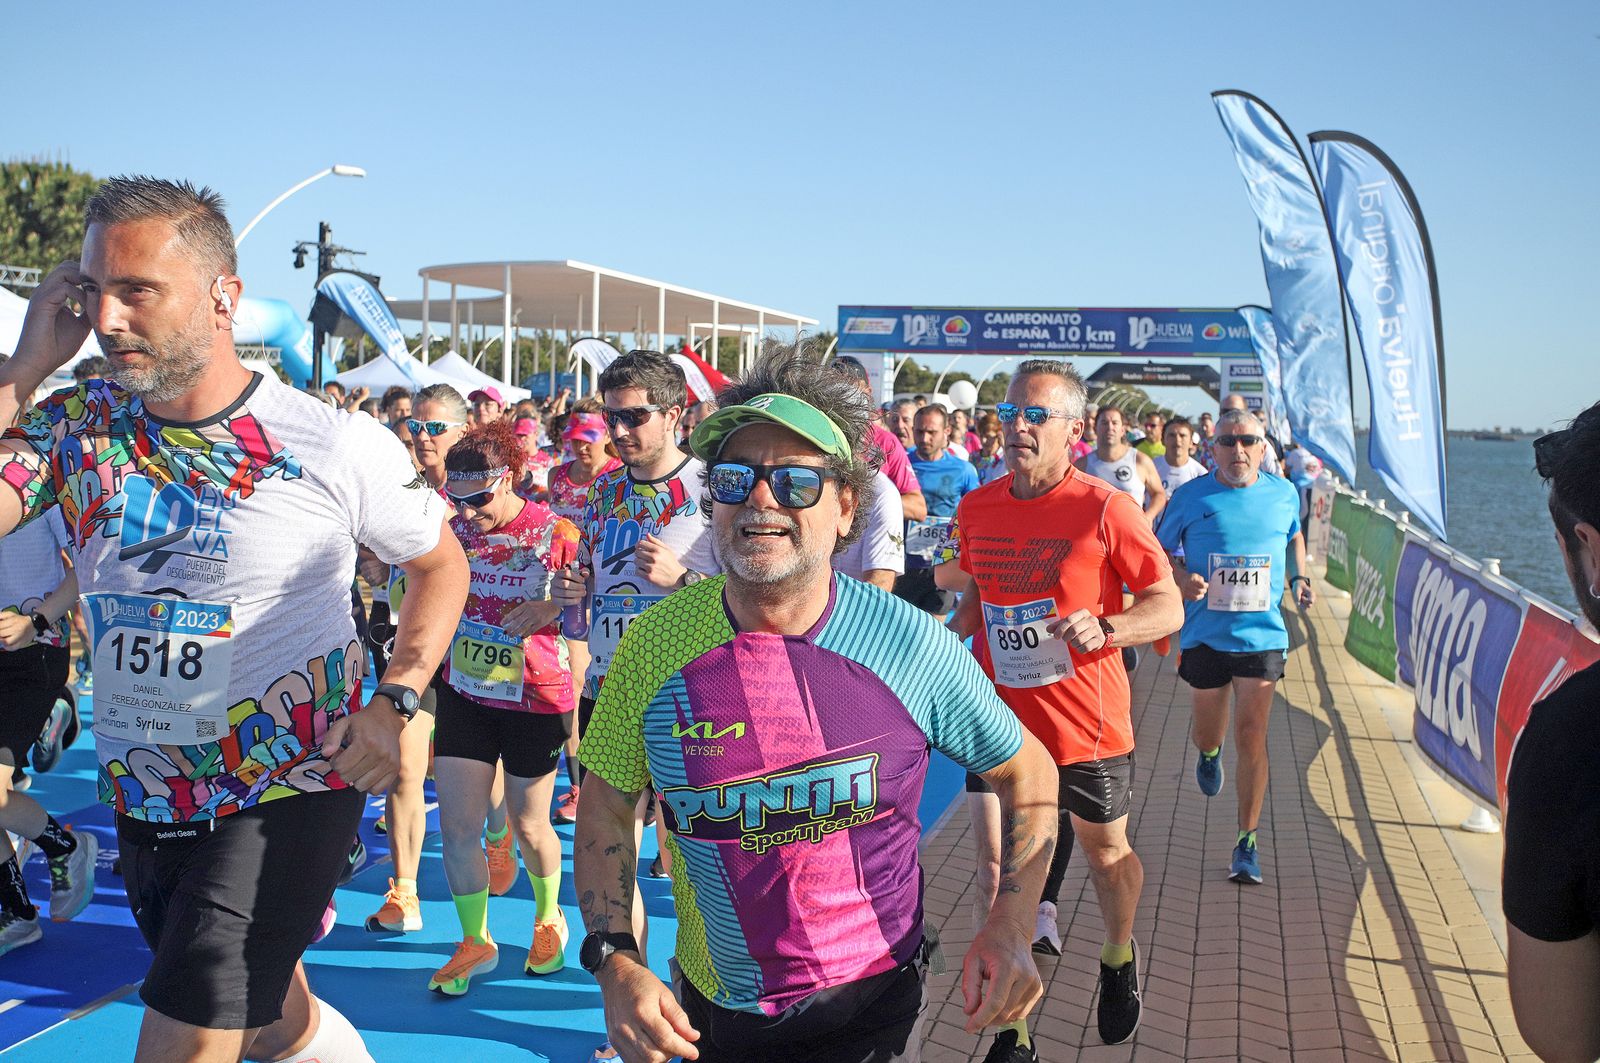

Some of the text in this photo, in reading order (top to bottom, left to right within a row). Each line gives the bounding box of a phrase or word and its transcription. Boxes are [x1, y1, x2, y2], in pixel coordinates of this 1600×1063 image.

[984, 312, 1081, 325] CAMPEONATO
[983, 325, 1115, 342] de ESPAÑA 10 km
[1154, 323, 1194, 337] HUELVA
[1047, 341, 1080, 350] Absoluto
[1088, 341, 1115, 350] Master
[195, 508, 232, 534] EL
[193, 531, 229, 558] VA
[186, 559, 227, 576] PUERTA DEL
[166, 567, 226, 586] DESCUBRIMIENTO
[500, 574, 526, 587] FIT
[1218, 570, 1258, 586] 1441
[118, 604, 145, 618] HUELVA
[175, 609, 219, 630] 2023
[1021, 605, 1048, 621] 2023
[997, 626, 1039, 651] 890
[111, 632, 203, 681] 1518
[462, 639, 512, 667] 1796
[1018, 672, 1041, 681] Syrluz
[133, 684, 163, 697] DANIEL
[112, 693, 192, 713] PEREZA GONZÁLEZ
[135, 716, 171, 732] Syrluz
[671, 721, 746, 740] KIA
[684, 745, 725, 757] VEYSER
[177, 829, 197, 838] Gears
